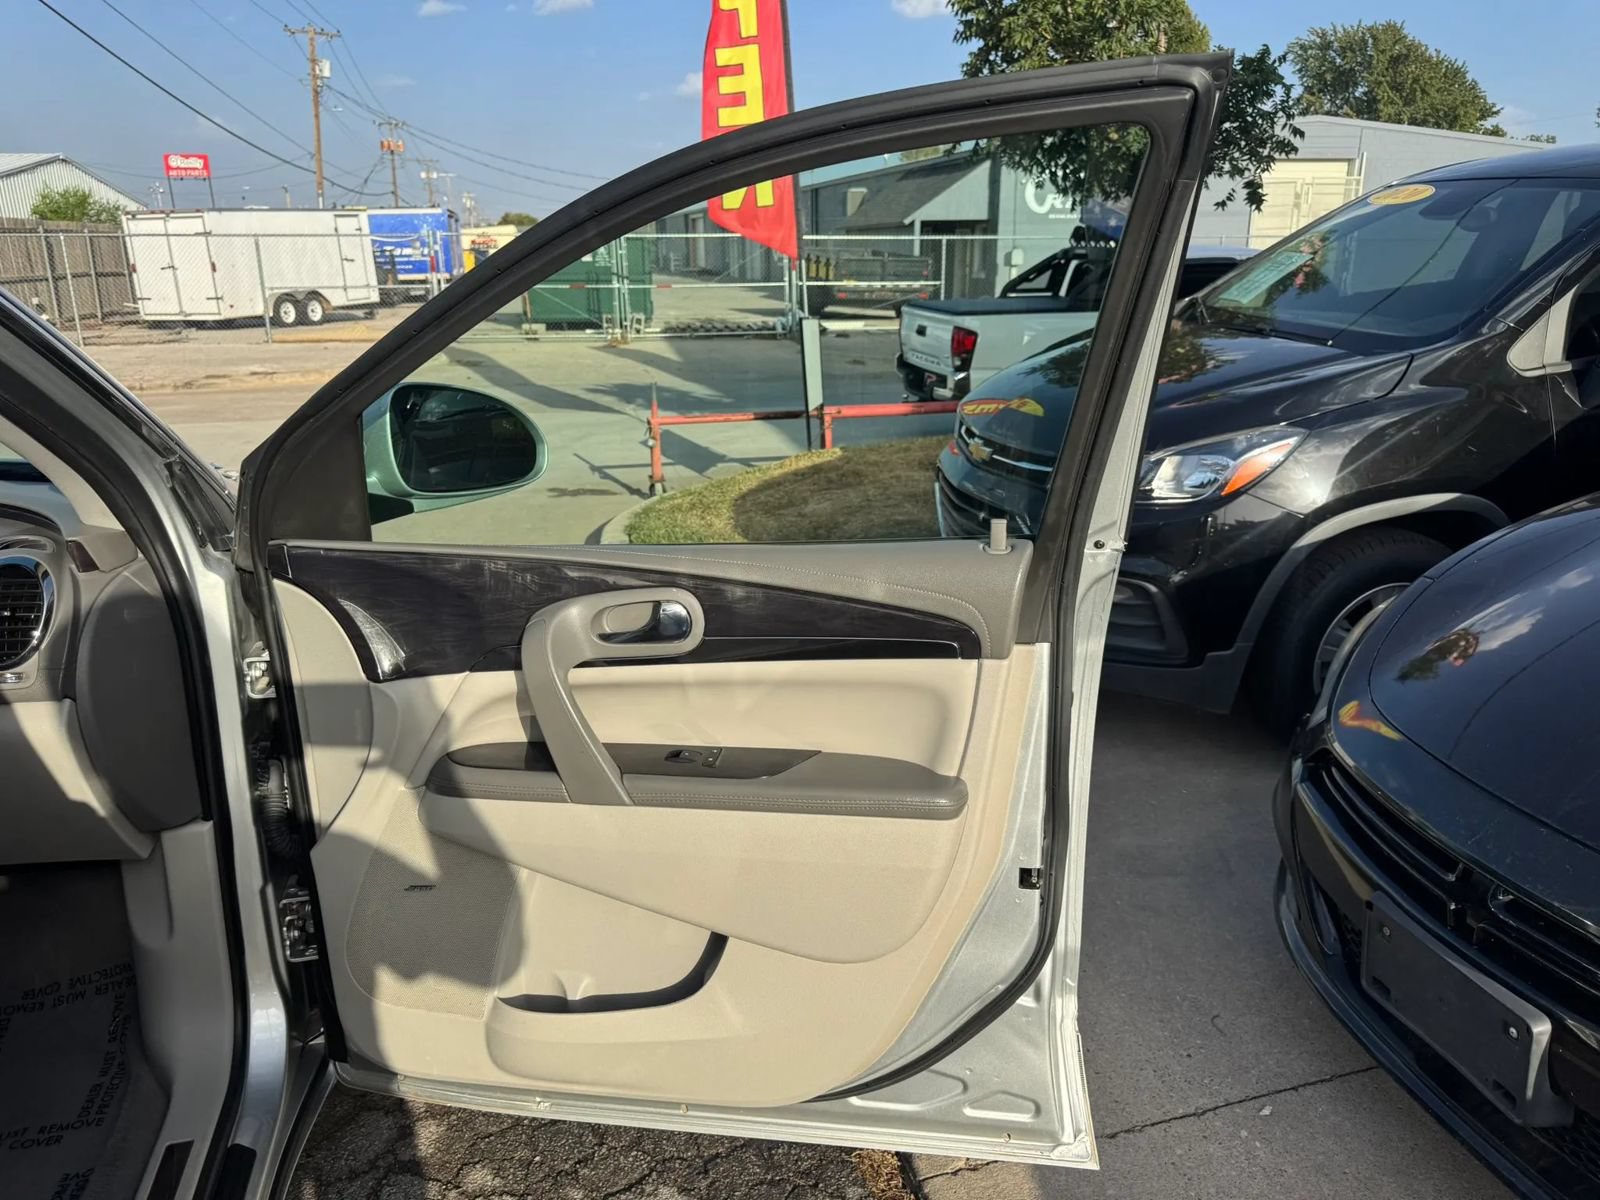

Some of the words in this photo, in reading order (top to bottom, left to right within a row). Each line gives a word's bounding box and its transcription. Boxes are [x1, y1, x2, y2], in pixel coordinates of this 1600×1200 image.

[52, 989, 87, 1009] MUST
[0, 1001, 45, 1017] REMO
[0, 1126, 32, 1141] UST
[36, 1116, 105, 1136] REMOVE
[8, 1134, 65, 1151] COVER
